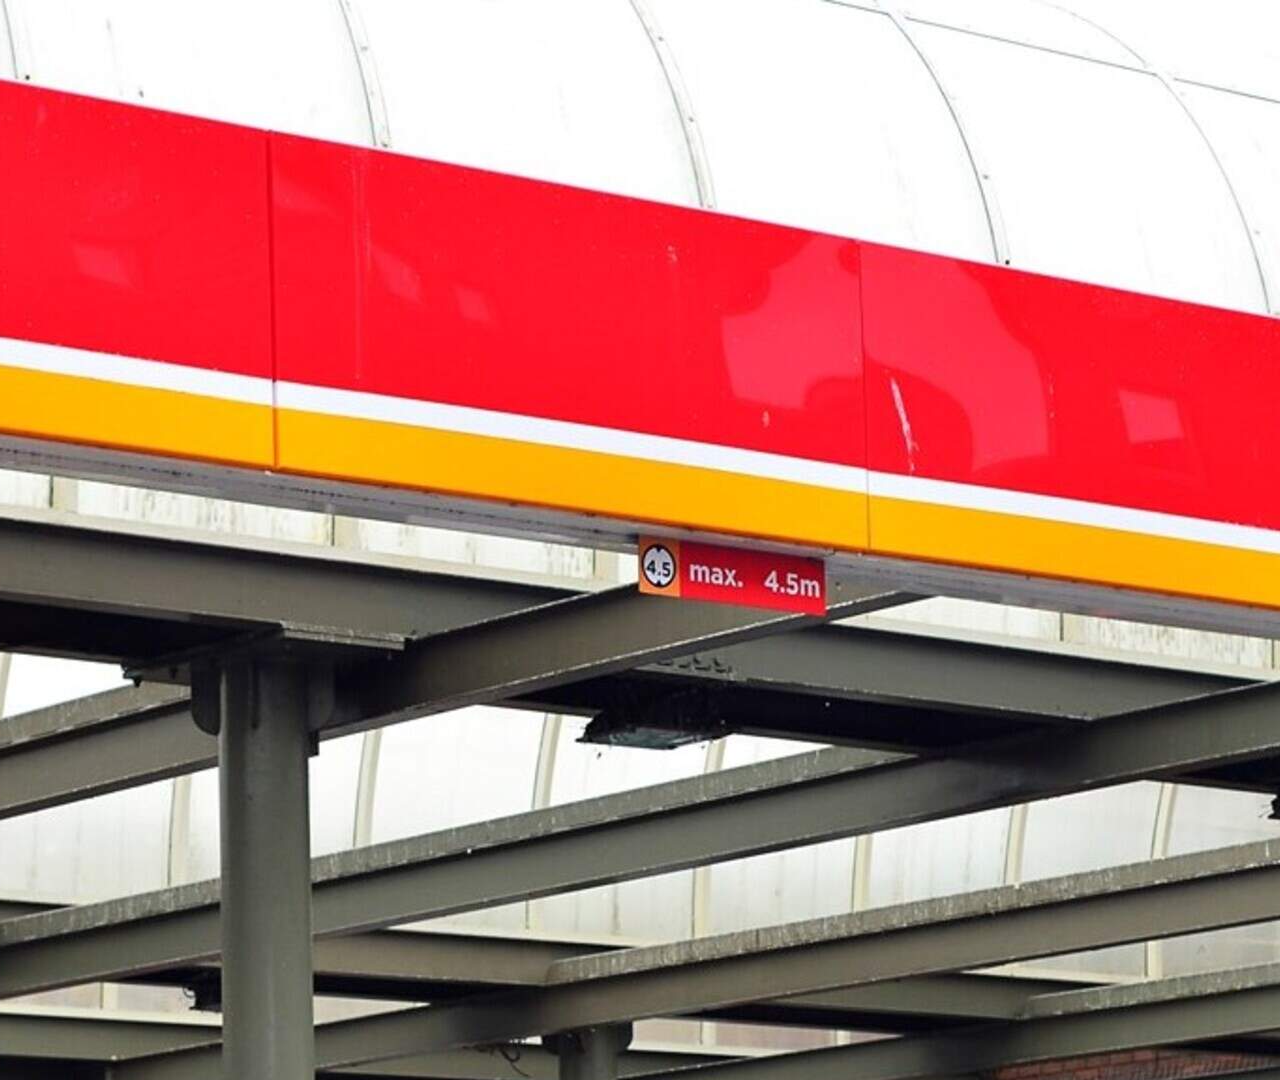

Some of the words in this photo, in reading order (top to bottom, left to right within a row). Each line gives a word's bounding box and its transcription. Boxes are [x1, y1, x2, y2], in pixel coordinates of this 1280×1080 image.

[646, 559, 671, 579] 4.5
[689, 563, 744, 588] max.
[763, 570, 821, 598] 4.5m
